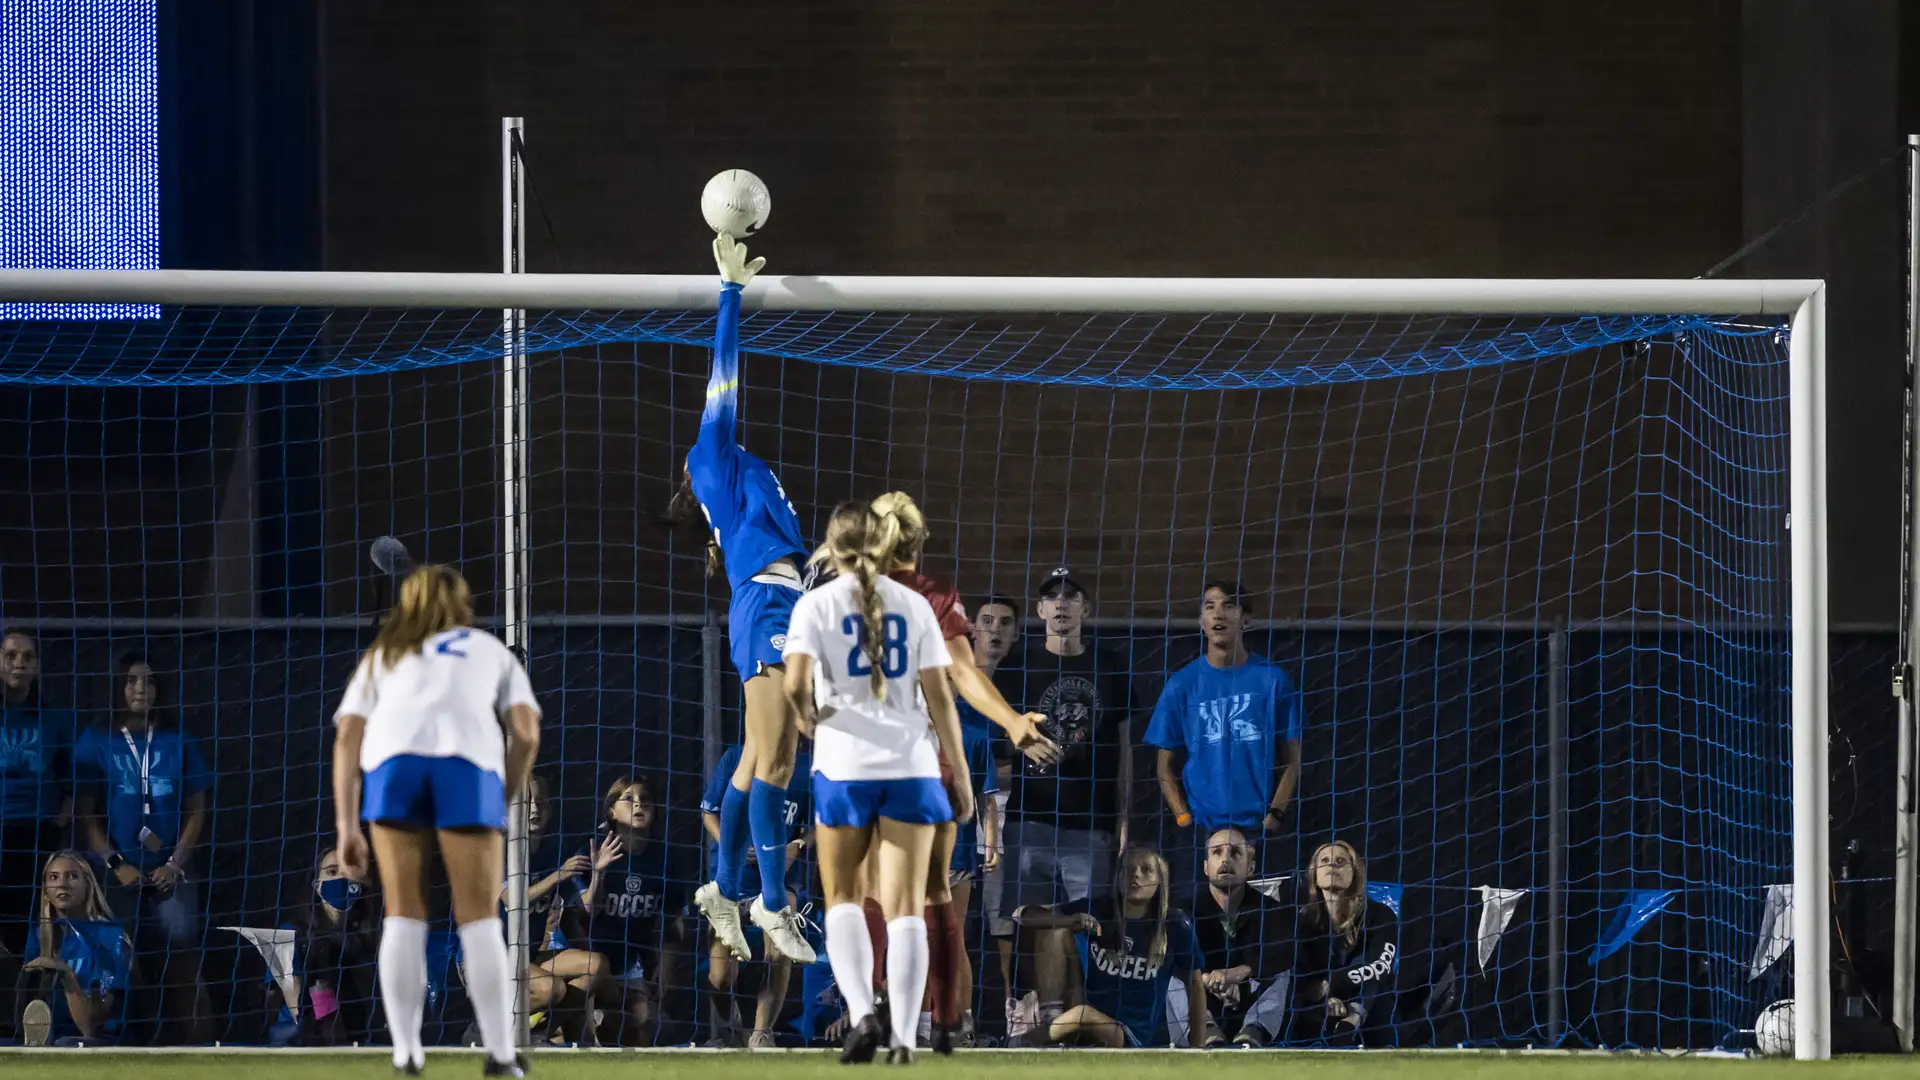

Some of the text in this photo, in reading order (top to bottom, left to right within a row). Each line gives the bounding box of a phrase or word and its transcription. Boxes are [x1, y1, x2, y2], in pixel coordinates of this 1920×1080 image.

[437, 630, 470, 658] 2
[842, 613, 907, 678] 28
[605, 893, 663, 918] OCCE
[1090, 941, 1159, 981] SOCCER
